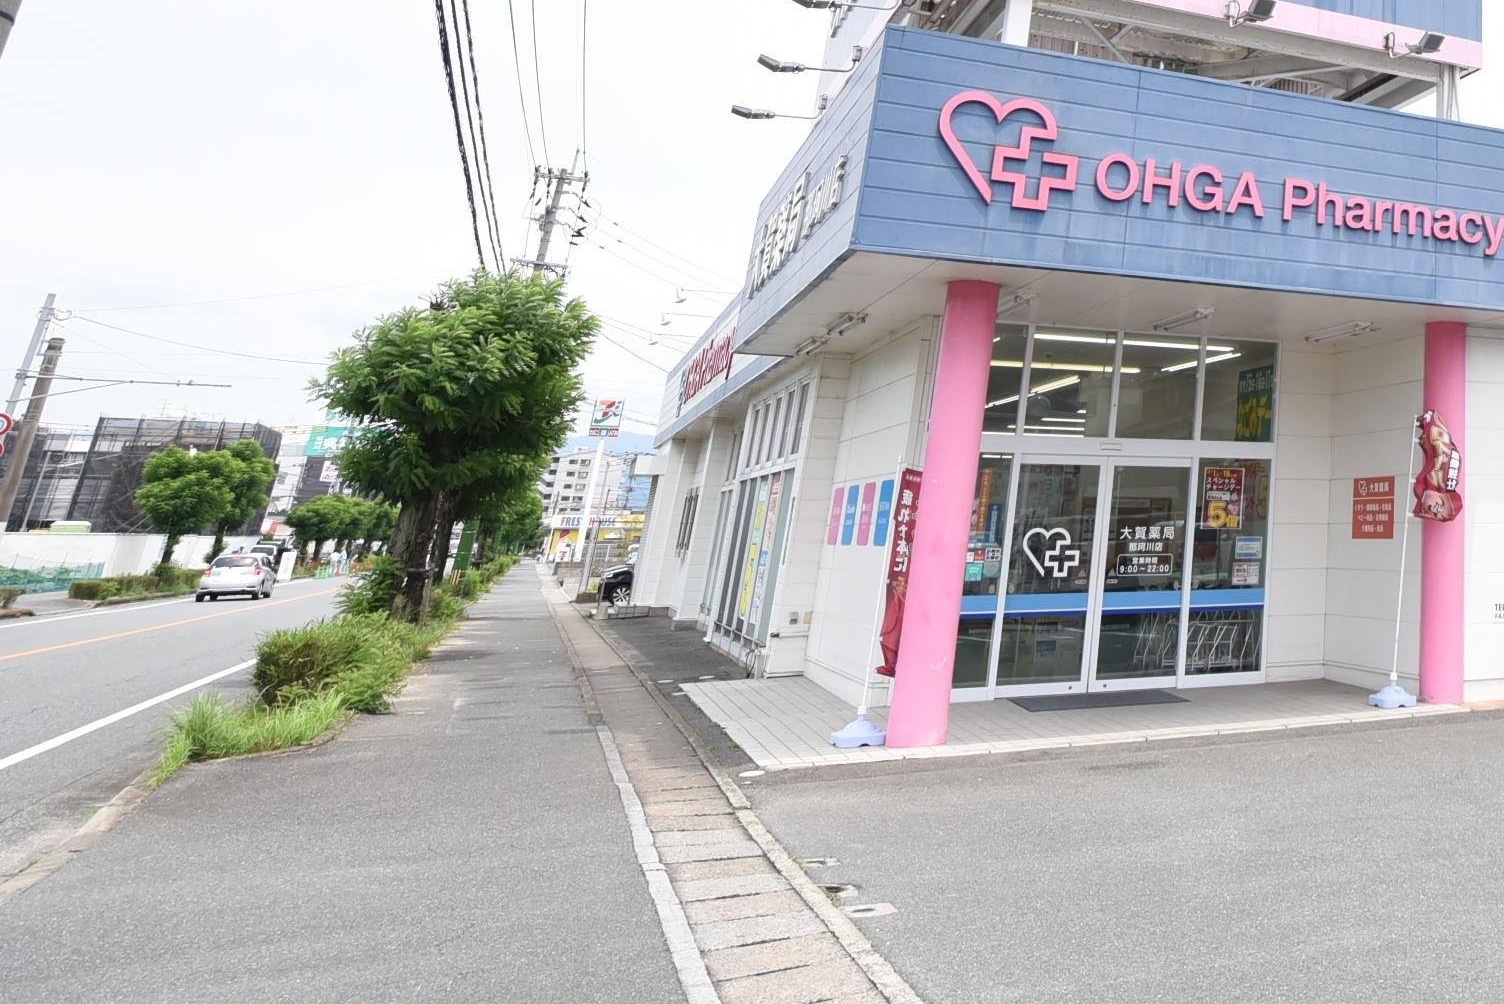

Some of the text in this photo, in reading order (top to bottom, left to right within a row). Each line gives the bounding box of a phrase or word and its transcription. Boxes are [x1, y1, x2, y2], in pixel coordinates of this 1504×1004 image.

[1096, 153, 1265, 218] OHGA
[560, 516, 583, 526] FRES
[1120, 526, 1175, 540] 大賀薬局
